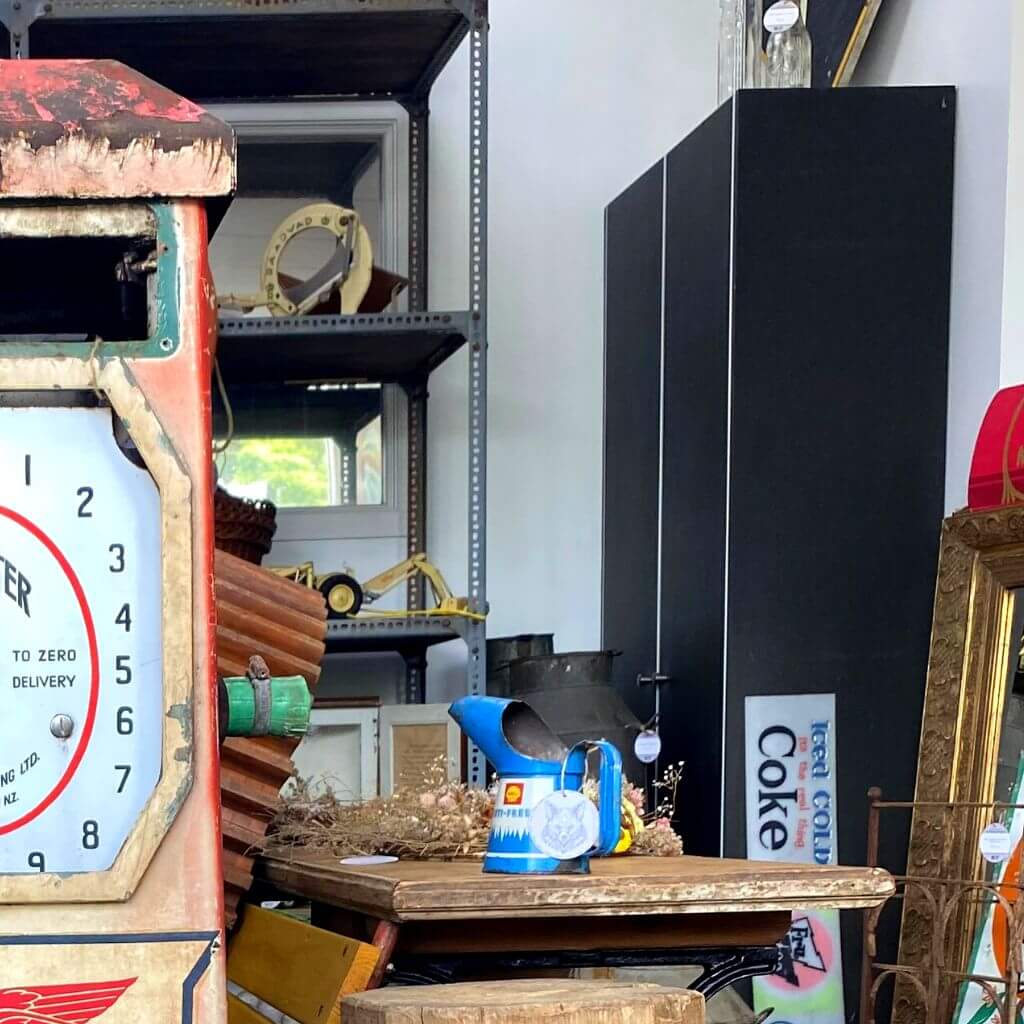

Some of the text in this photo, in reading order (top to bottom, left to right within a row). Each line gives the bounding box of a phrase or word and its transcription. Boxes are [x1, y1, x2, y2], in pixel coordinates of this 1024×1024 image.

[24, 454, 32, 486] 1
[76, 486, 94, 518] 2
[109, 543, 126, 573] 3
[115, 603, 132, 632] 4
[12, 650, 31, 662] TO
[38, 649, 76, 662] ZERO
[115, 655, 132, 685] 5
[12, 675, 76, 689] DELIVERY
[116, 706, 134, 736] 6
[113, 764, 132, 794] 7
[758, 725, 799, 851] Coke
[797, 787, 810, 811] real
[82, 820, 100, 850] 8
[794, 818, 809, 848] thing
[812, 790, 832, 865] COLD
